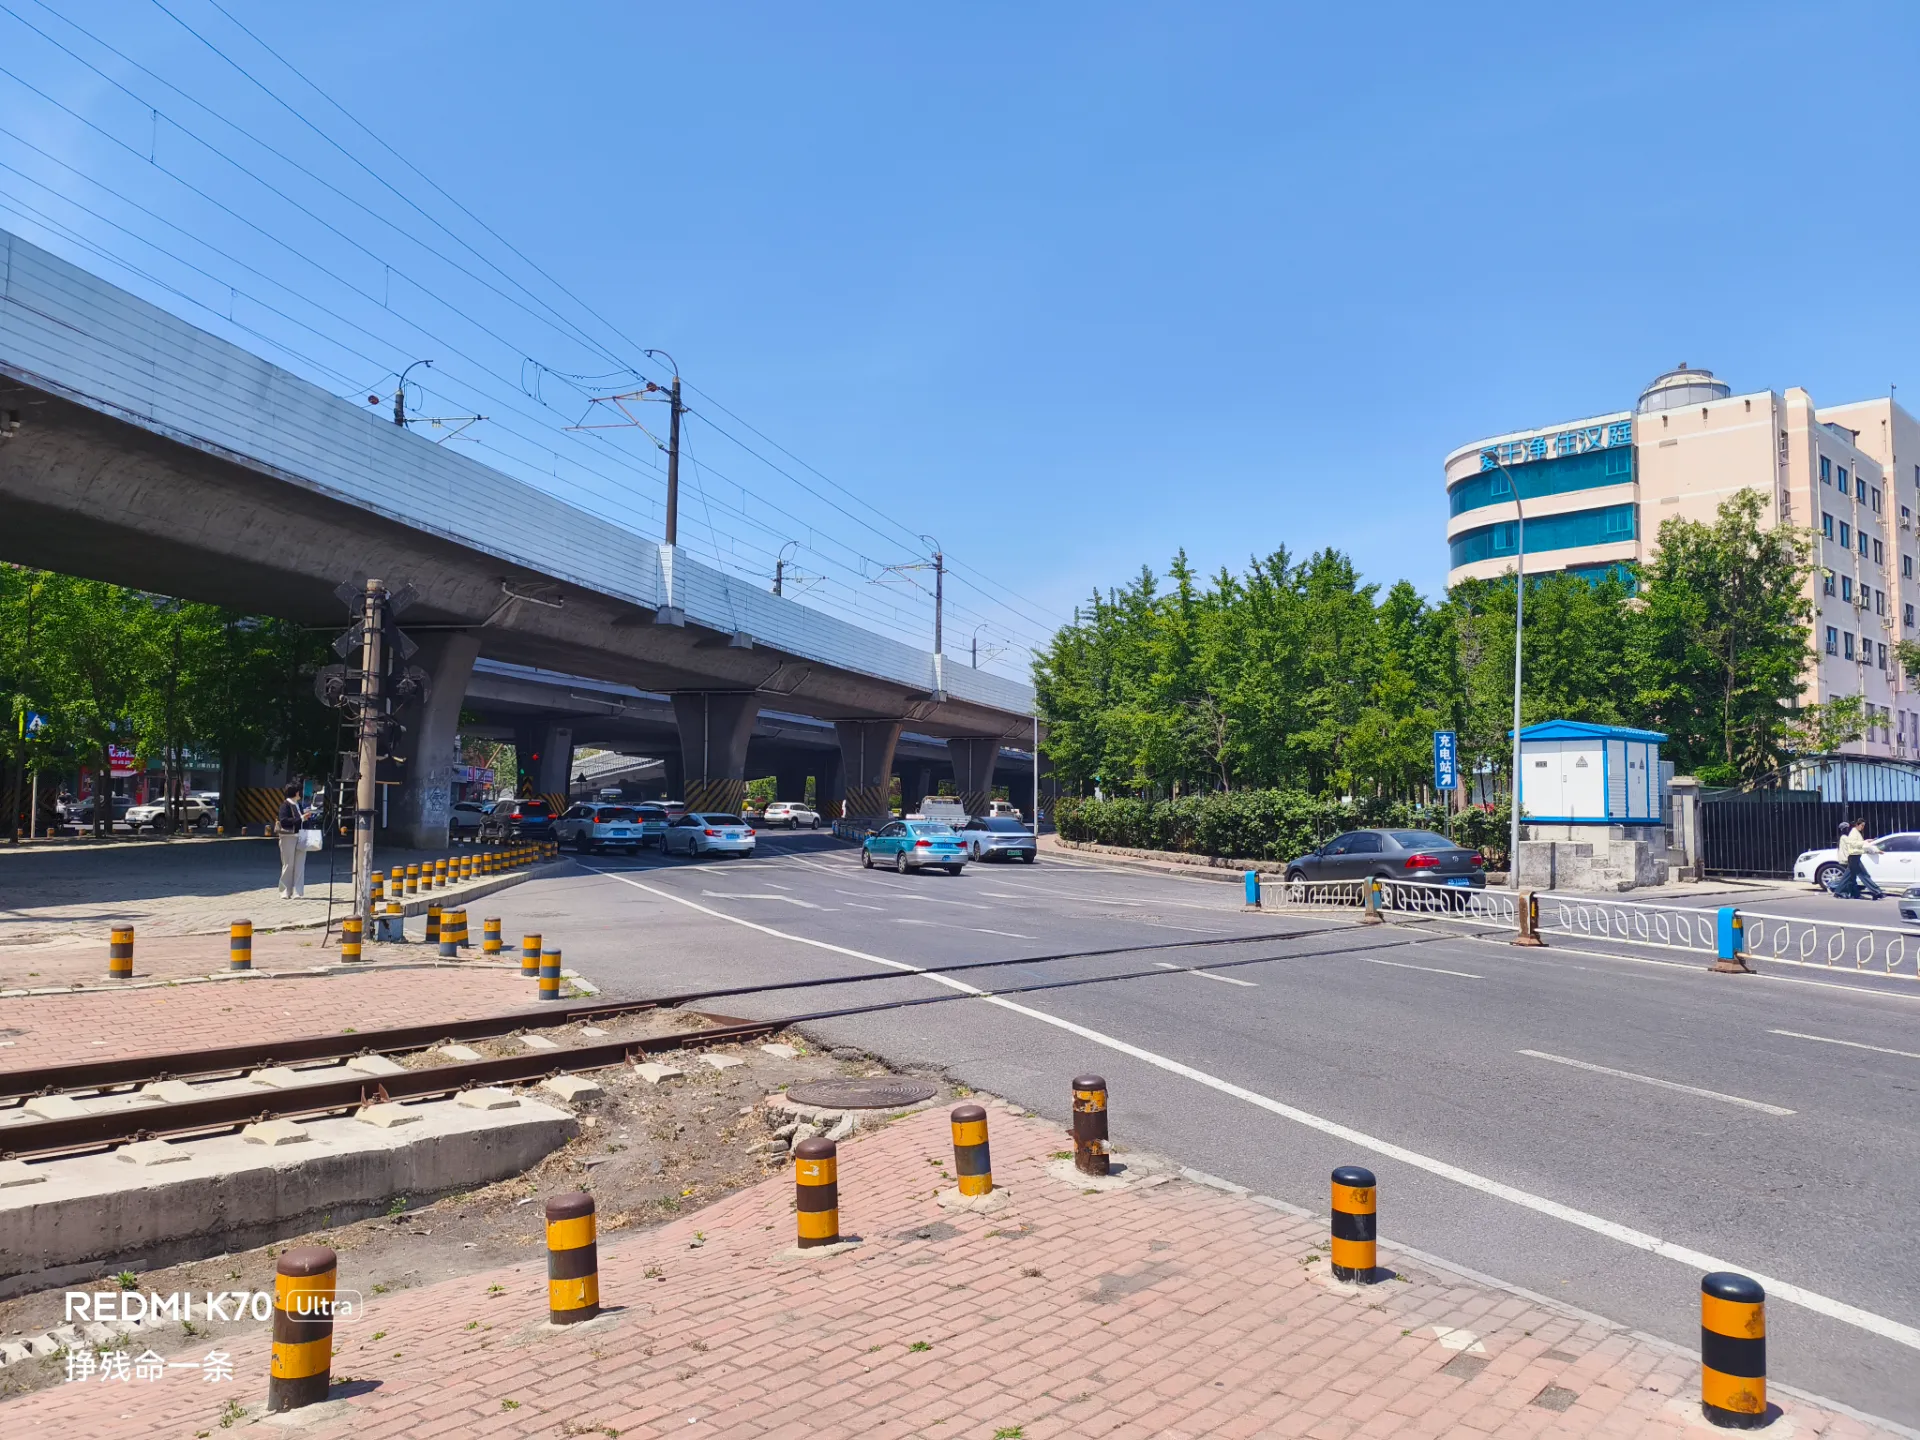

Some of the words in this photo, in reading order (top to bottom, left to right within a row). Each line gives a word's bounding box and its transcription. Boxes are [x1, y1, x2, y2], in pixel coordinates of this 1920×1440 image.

[1480, 436, 1548, 472] 爱干净
[1554, 421, 1632, 457] 住汉庭
[1438, 734, 1452, 774] 充电站
